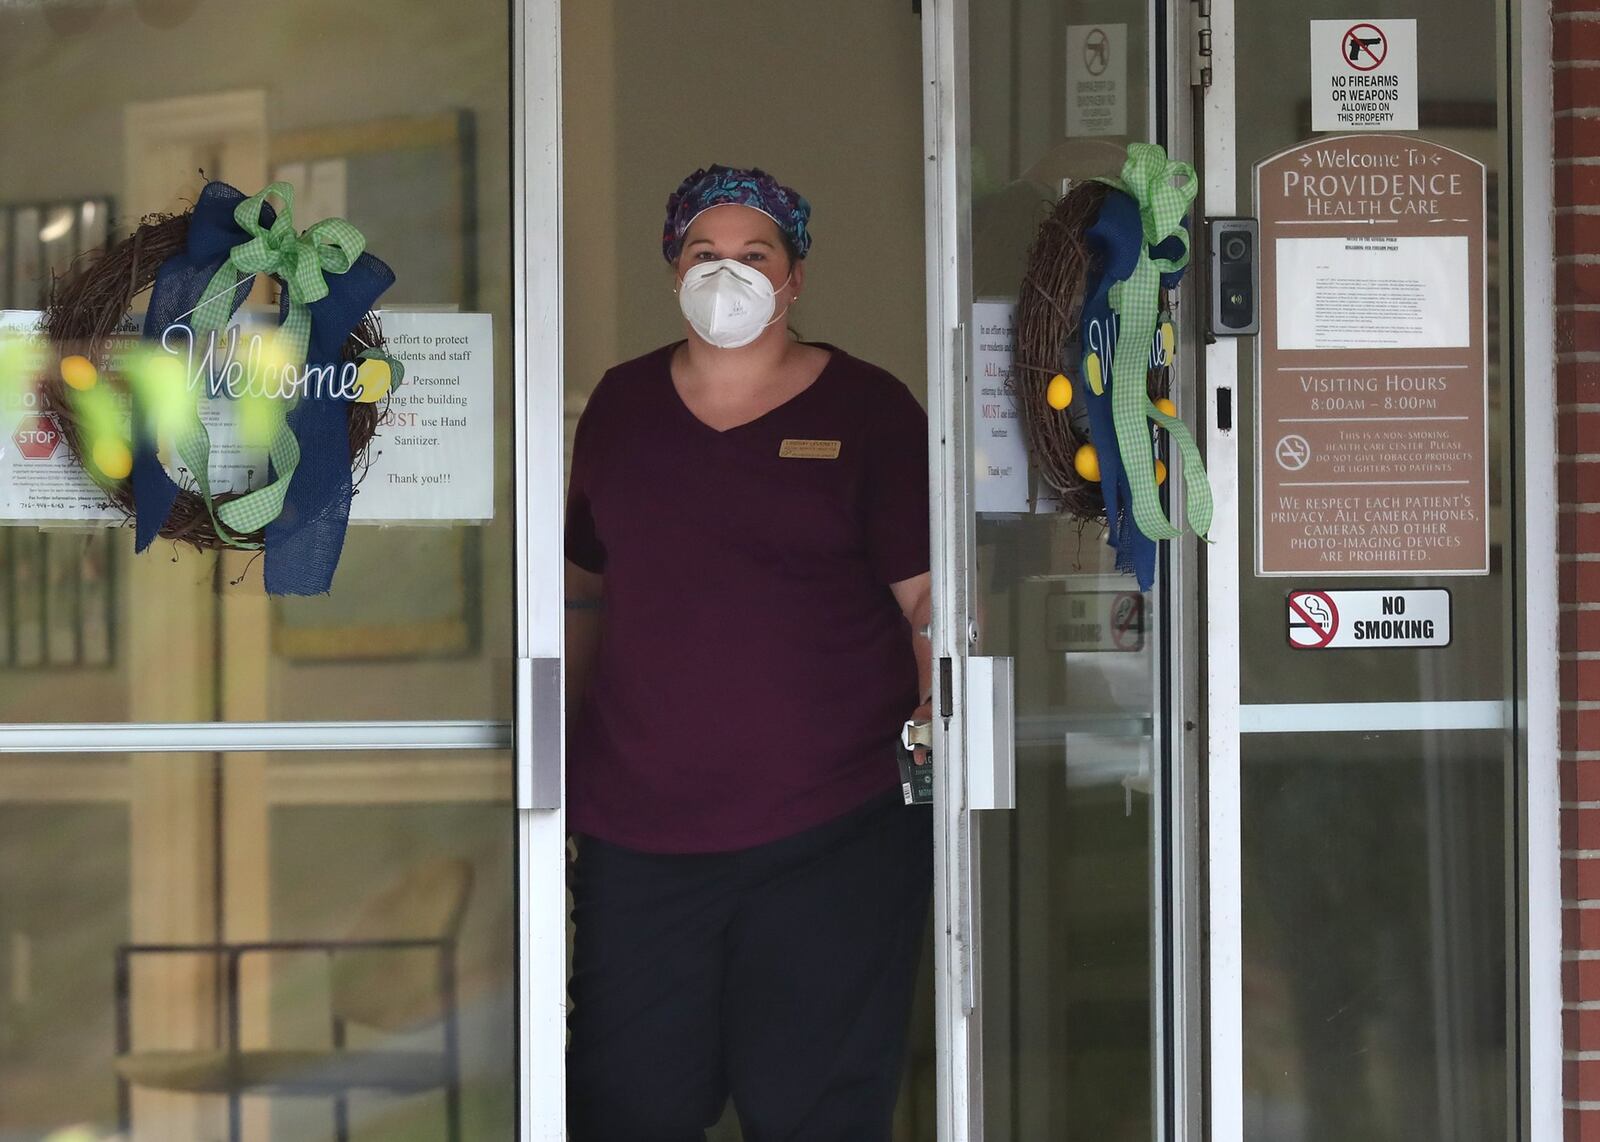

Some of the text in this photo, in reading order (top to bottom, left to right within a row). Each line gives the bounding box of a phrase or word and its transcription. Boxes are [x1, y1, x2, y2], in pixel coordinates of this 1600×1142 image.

[1331, 75, 1398, 87] NO FIREARMS
[1332, 89, 1398, 101] OR WEAPONS
[1341, 103, 1390, 112] ALLOWED ON
[1337, 113, 1394, 122] THIS PROPERTY
[1316, 149, 1426, 168] Welcome To
[1283, 171, 1463, 197] PROVIDENCE
[1307, 197, 1439, 216] HEALTH CARE
[393, 334, 420, 345] effort
[423, 336, 432, 345] to
[435, 335, 469, 348] protect
[162, 324, 363, 399] Welcome
[385, 350, 472, 361] sidents and staff
[413, 375, 460, 386] Personnel
[1300, 375, 1447, 392] VISITING HOURS
[409, 395, 424, 405] the
[427, 394, 468, 407] building
[1311, 397, 1365, 410] 8:00AM
[1384, 396, 1437, 410] 8:00PM
[421, 419, 438, 427] use
[440, 416, 467, 427] Hand
[19, 430, 56, 444] STOP
[394, 435, 440, 446] Sanitizer.
[1340, 431, 1360, 440] THIS
[1363, 432, 1371, 440] IS
[1326, 443, 1361, 451] HEALTH
[1363, 443, 1385, 451] CARE
[1430, 440, 1462, 450] PLEASE
[1316, 453, 1472, 462] DO NOT GIVE TOBACCO PRODUCTS
[1333, 465, 1346, 473] OR
[1348, 464, 1391, 473] LIGHTERS
[1394, 464, 1407, 472] TO
[387, 473, 451, 486] Thank you!!!
[1279, 493, 1471, 510] WE RESPECT EACH PATIENT'S
[1271, 509, 1479, 523] PRIVACY. ALL CAMERA PHONES,
[1304, 523, 1447, 536] CAMERAS AND OTHER
[1290, 536, 1462, 549] PHOTO-IMAGING DEVICES
[1319, 549, 1431, 562] ARE PROHIBITED.
[1382, 596, 1405, 615] NO
[1354, 619, 1434, 640] SMOKING
